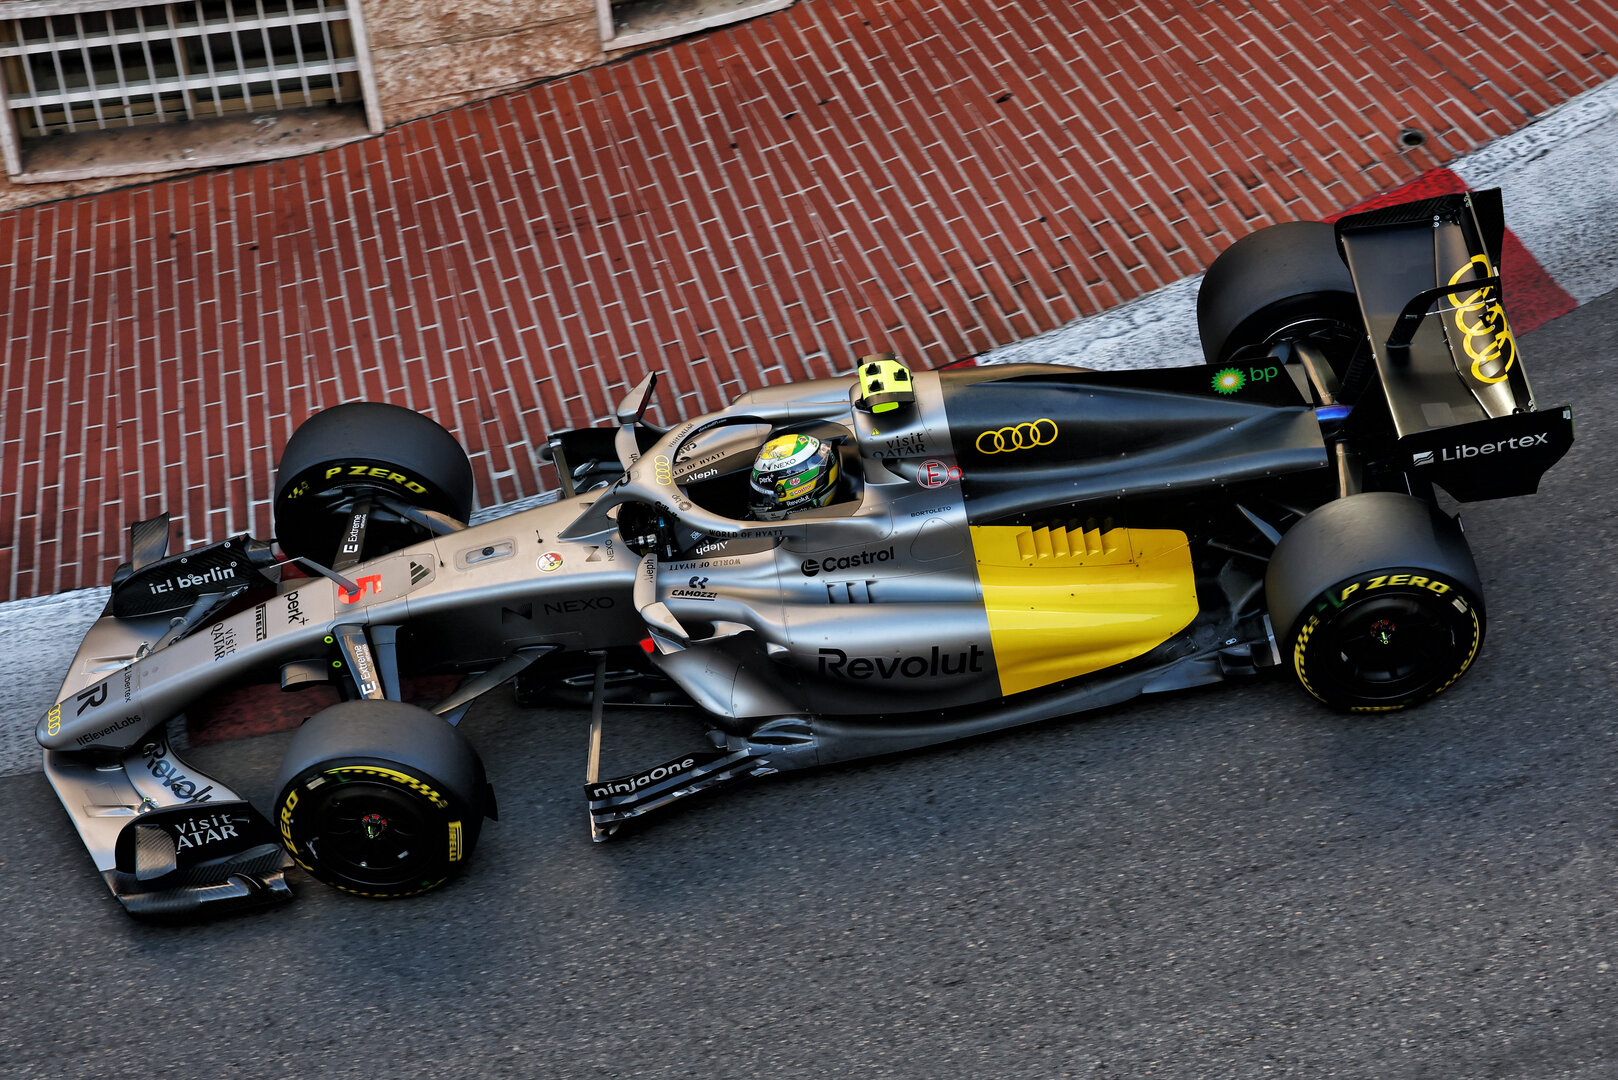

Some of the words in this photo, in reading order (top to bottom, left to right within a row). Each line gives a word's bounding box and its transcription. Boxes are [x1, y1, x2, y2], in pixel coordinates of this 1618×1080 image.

[1250, 365, 1279, 385] bp
[886, 432, 924, 449] visit
[1442, 432, 1548, 462] Libertex
[699, 451, 725, 465] HYATT
[773, 458, 796, 469] NEXO
[326, 467, 342, 480] P
[348, 466, 428, 494] ZERO
[686, 468, 718, 483] Aleph
[910, 505, 951, 517] BORTOLETO
[348, 514, 361, 542] Extreme
[709, 529, 738, 538] WORLD
[741, 530, 753, 538] OF
[755, 529, 784, 538] HYATT
[605, 540, 615, 561] NEXO
[822, 546, 895, 573] Castrol
[178, 566, 235, 592] berlin
[669, 562, 696, 571] HYATT
[671, 589, 717, 599] CAMOZZI
[1341, 583, 1360, 601] P
[1365, 574, 1453, 594] ZERO
[544, 596, 615, 616] NEXO
[255, 603, 267, 642] PIRELLI
[211, 622, 225, 661] QATAR
[225, 628, 237, 656] visit
[354, 645, 371, 681] Extreme
[818, 645, 984, 680] Revolut
[124, 670, 132, 703] Libertex
[593, 757, 694, 798] ninjaOne
[175, 814, 232, 834] visit
[175, 824, 239, 855] ATAR
[448, 820, 463, 861] PIRELLI
